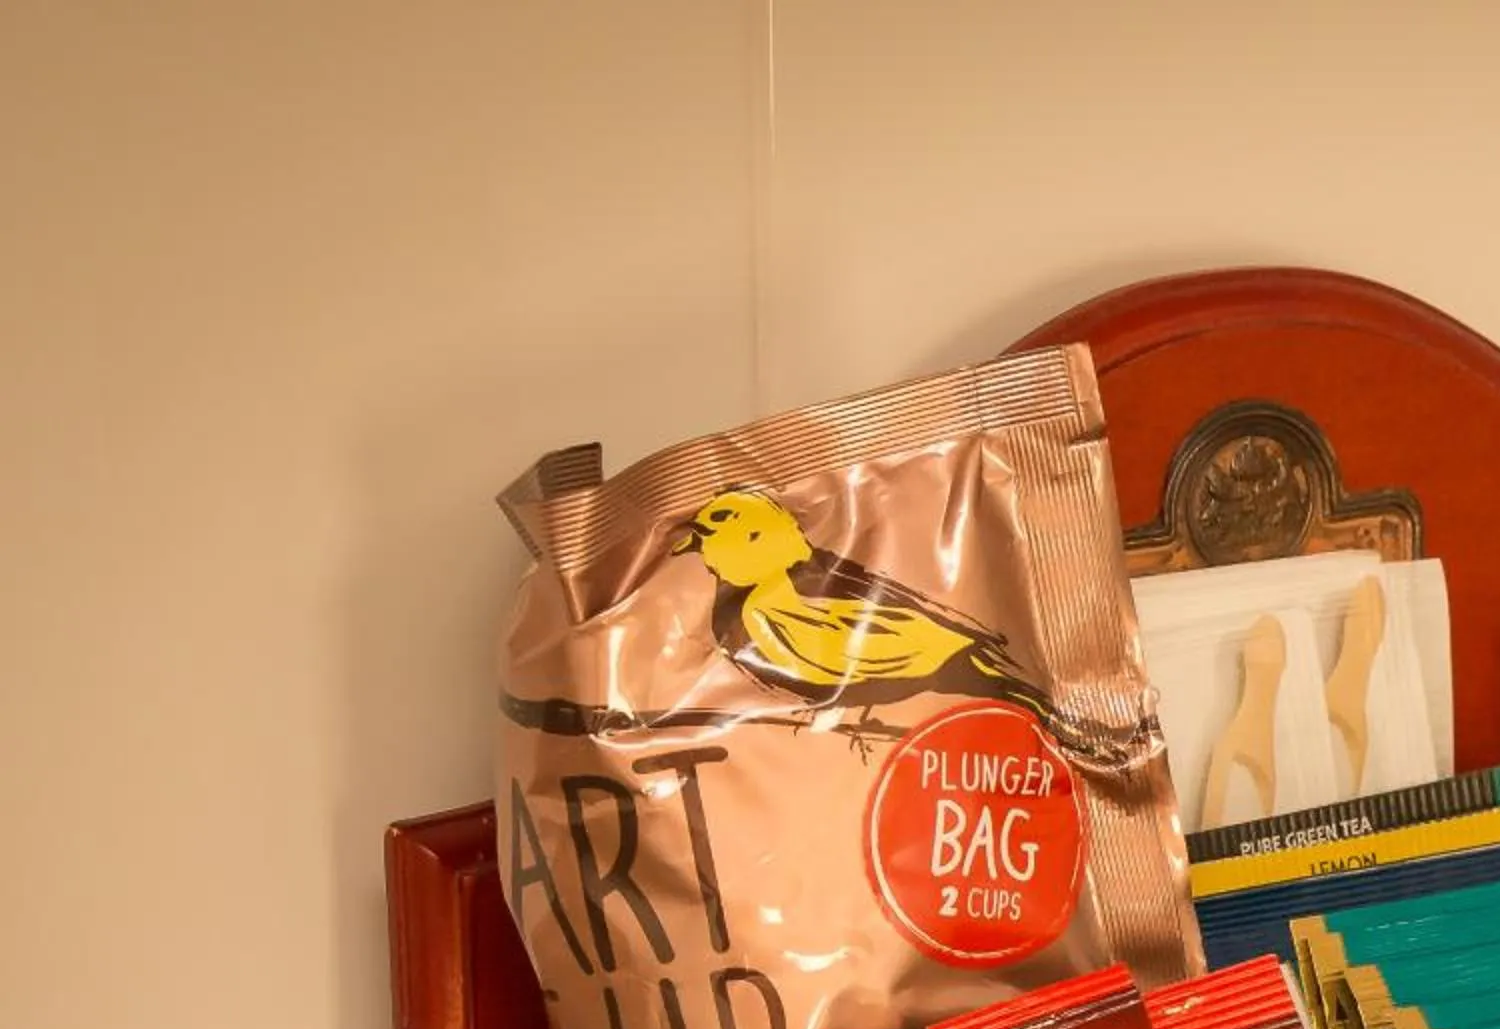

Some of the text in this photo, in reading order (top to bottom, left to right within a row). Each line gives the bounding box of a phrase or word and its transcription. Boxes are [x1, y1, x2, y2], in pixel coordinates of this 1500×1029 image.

[921, 749, 1055, 798] PLUNGER
[931, 798, 1040, 882] BAG
[1284, 822, 1339, 850] GREEN
[1339, 815, 1374, 837] TEA
[1309, 851, 1377, 876] LEMON
[938, 885, 1022, 921] 2 CUPS
